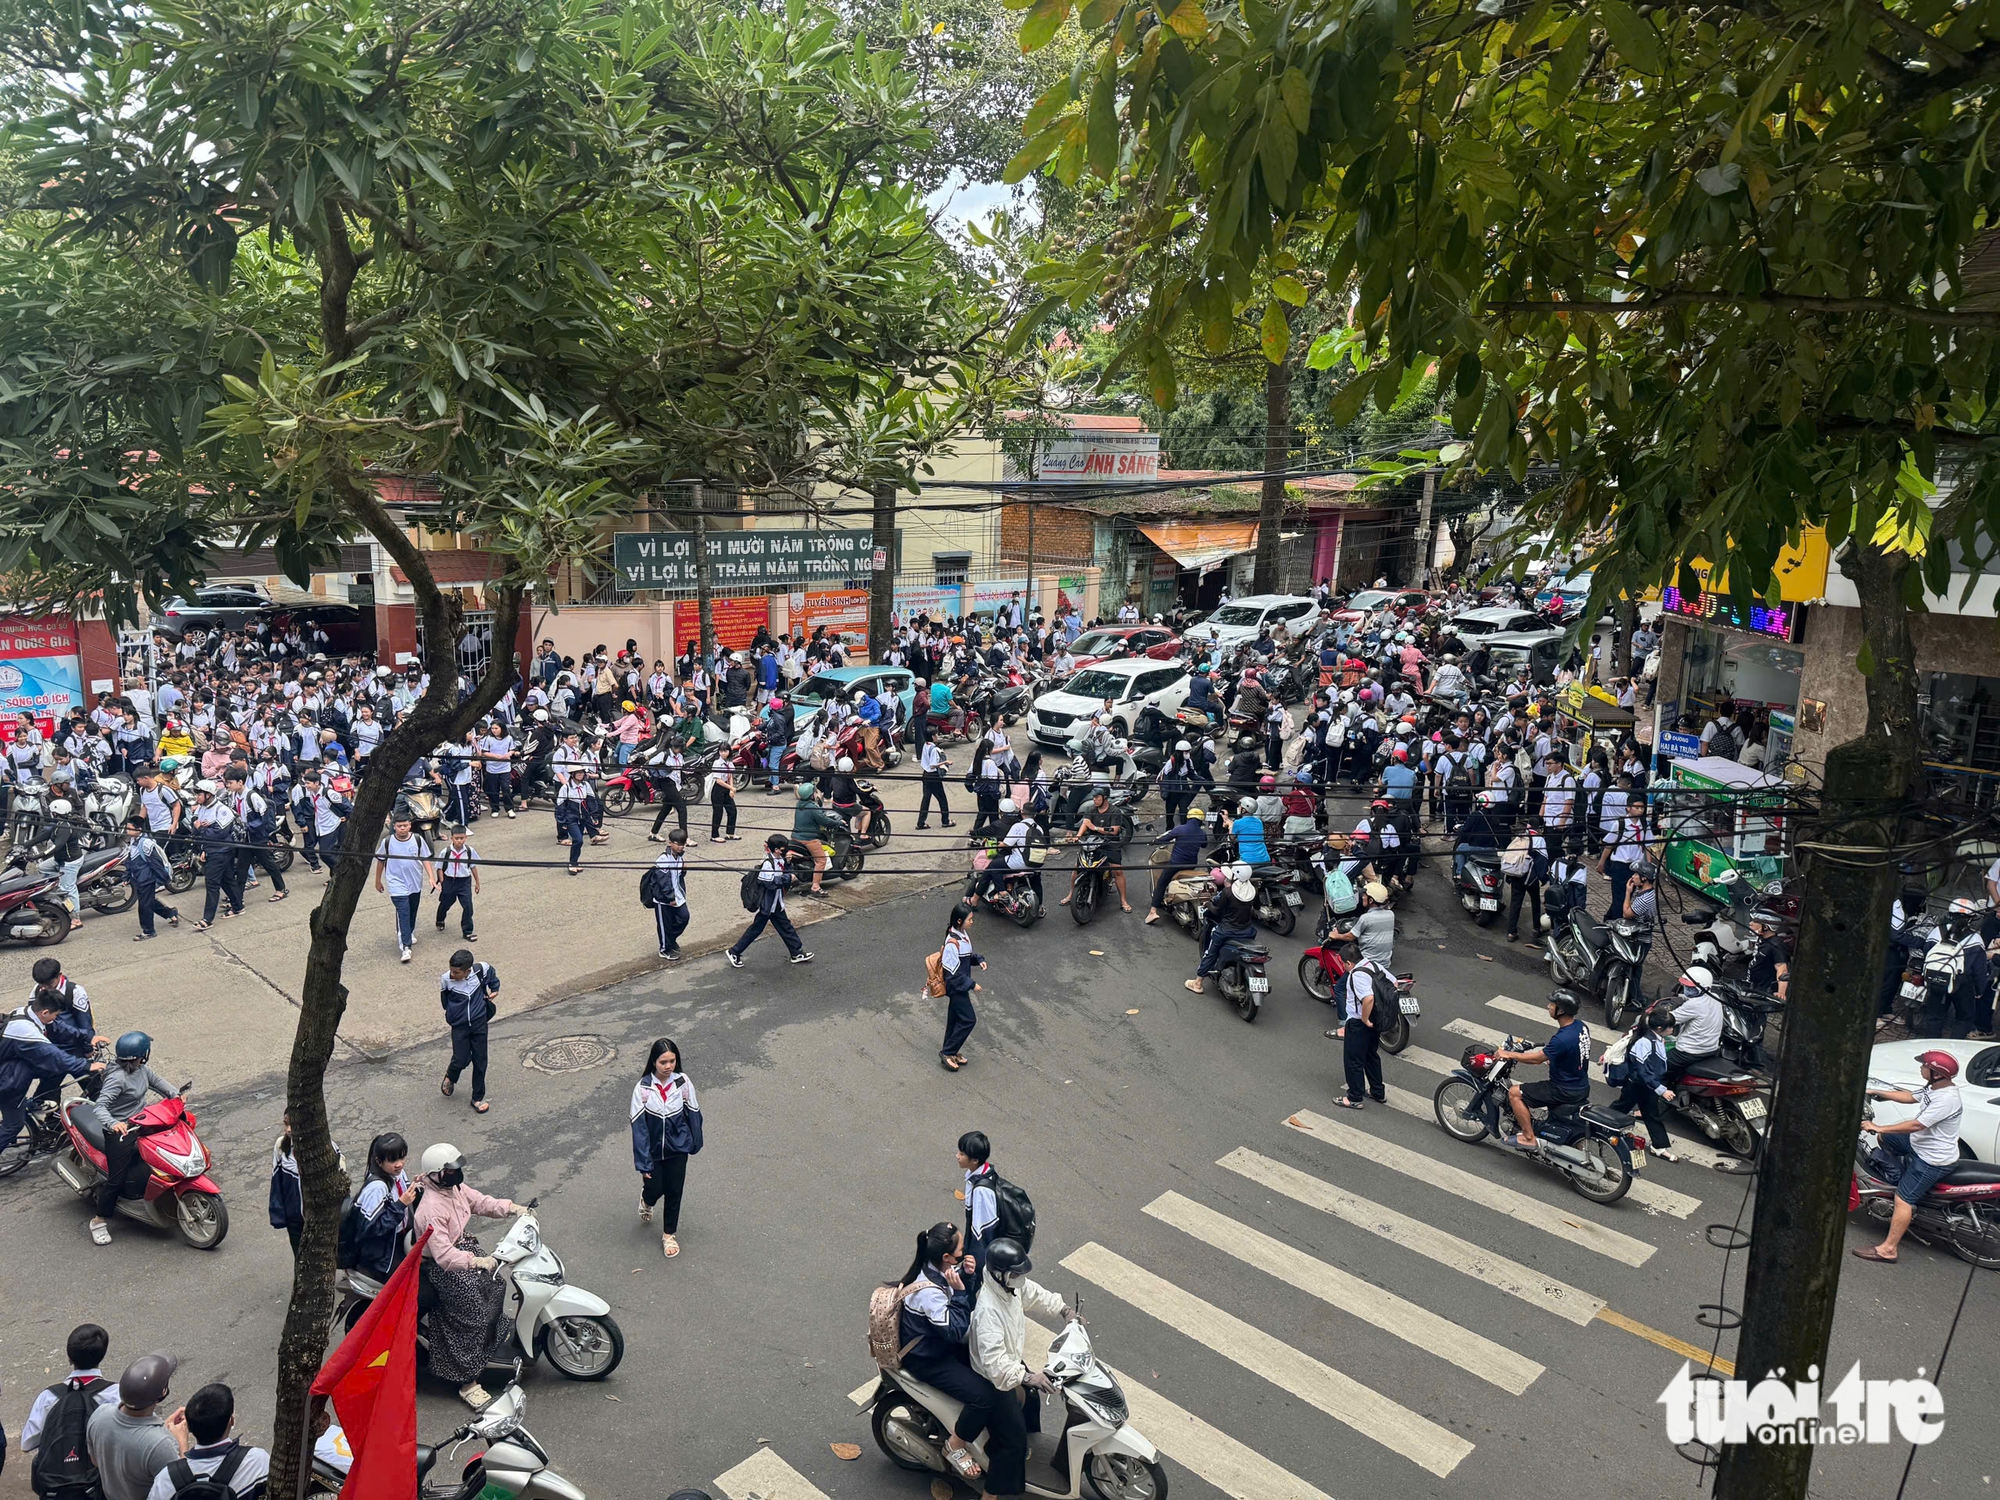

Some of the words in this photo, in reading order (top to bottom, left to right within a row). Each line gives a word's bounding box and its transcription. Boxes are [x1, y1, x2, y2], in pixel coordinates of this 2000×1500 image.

[1084, 448, 1115, 474] ÁNH
[1117, 449, 1156, 475] SÁNG
[638, 538, 656, 557] VÌ
[662, 539, 690, 560] LỢI
[727, 535, 764, 555] MƯỜI
[770, 535, 803, 554] NĂM
[808, 533, 854, 552] TRỒNG
[873, 551, 886, 560] VAY
[626, 562, 645, 581] VÌ
[651, 562, 678, 582] LỢI
[715, 558, 760, 577] TRĂM
[766, 557, 799, 576] NĂM
[803, 554, 850, 573] TRỒNG
[806, 593, 831, 608] TUYỂN
[832, 597, 850, 606] SINH
[14, 633, 46, 651] QUỐC
[50, 636, 70, 648] GIA
[6, 695, 33, 708] SỐNG
[1660, 742, 1670, 750] HAI
[1671, 743, 1679, 752] BÀ
[1680, 745, 1698, 756] TRƯNG
[1743, 1099, 1760, 1109] 47-B1
